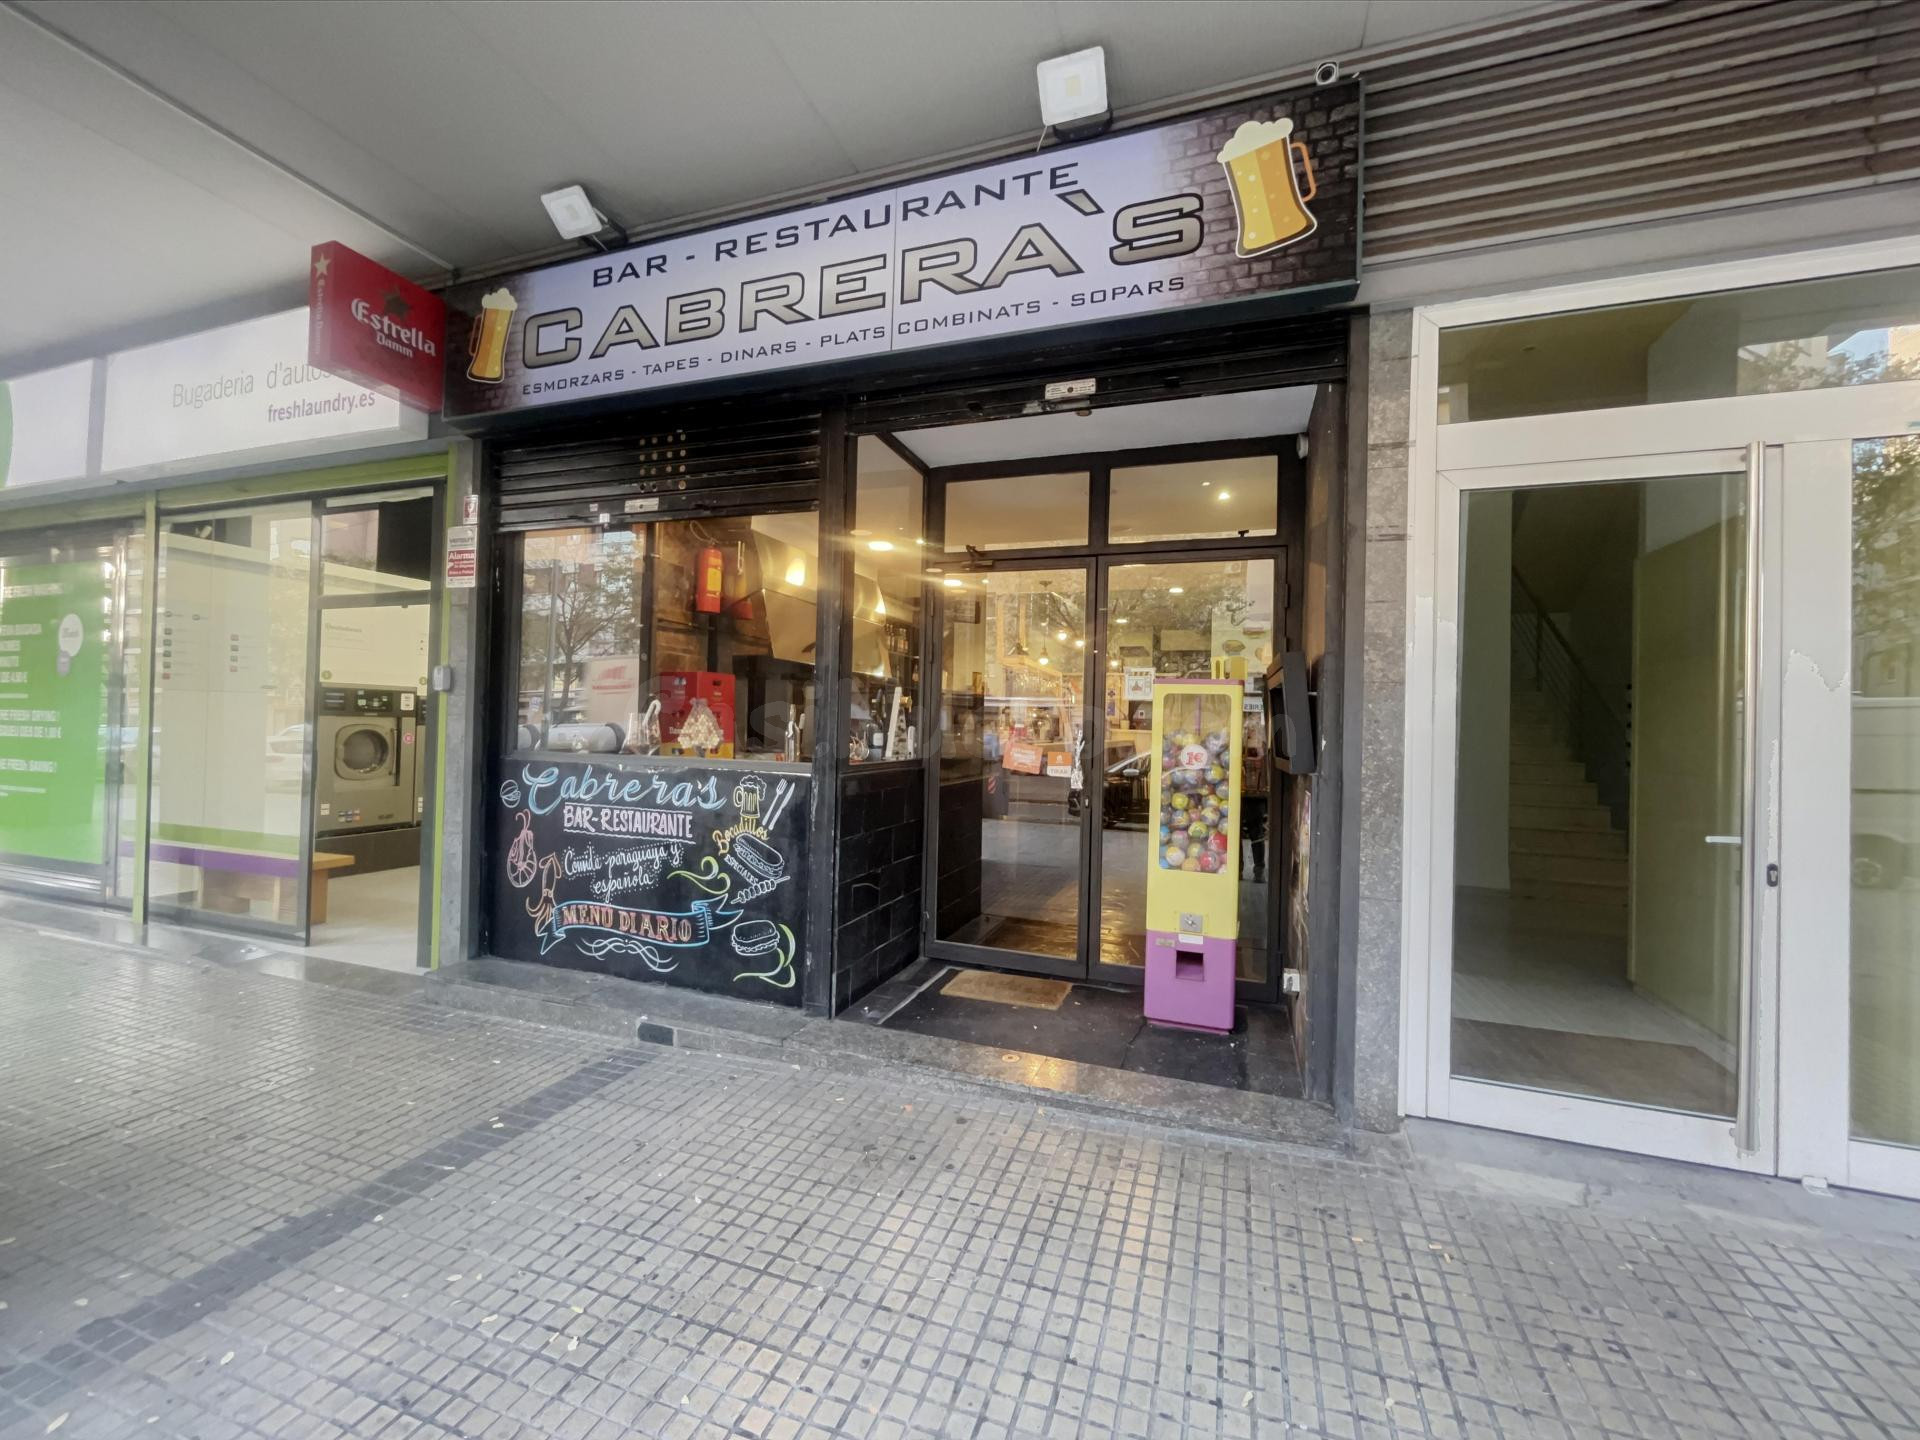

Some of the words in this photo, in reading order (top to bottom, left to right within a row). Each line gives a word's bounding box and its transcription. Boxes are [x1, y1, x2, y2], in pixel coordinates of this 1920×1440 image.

[592, 254, 669, 288] BAR
[715, 162, 1079, 262] RESTAURANTE
[351, 298, 436, 357] Estrella
[376, 332, 414, 358] Damm
[522, 369, 625, 396] ESMORZARS
[642, 356, 700, 376] TAPES
[720, 341, 797, 364] DINARS
[820, 326, 886, 348] PLATS
[897, 300, 1042, 335] COMBINATS
[1070, 277, 1185, 307] SOPARS
[172, 370, 255, 409] Bugaderia
[267, 391, 376, 423] freshlaundry.es
[448, 551, 475, 561] Alarma
[563, 806, 694, 839] BAR-RESTAURANTE
[712, 815, 771, 857] Bocadillos
[564, 845, 602, 876] Comida
[604, 845, 669, 879] paraguaya
[669, 842, 681, 866] y
[724, 853, 760, 887] ESPECIALES
[592, 865, 654, 904] española
[562, 904, 614, 929] MENU
[618, 910, 692, 943] DIARIO
